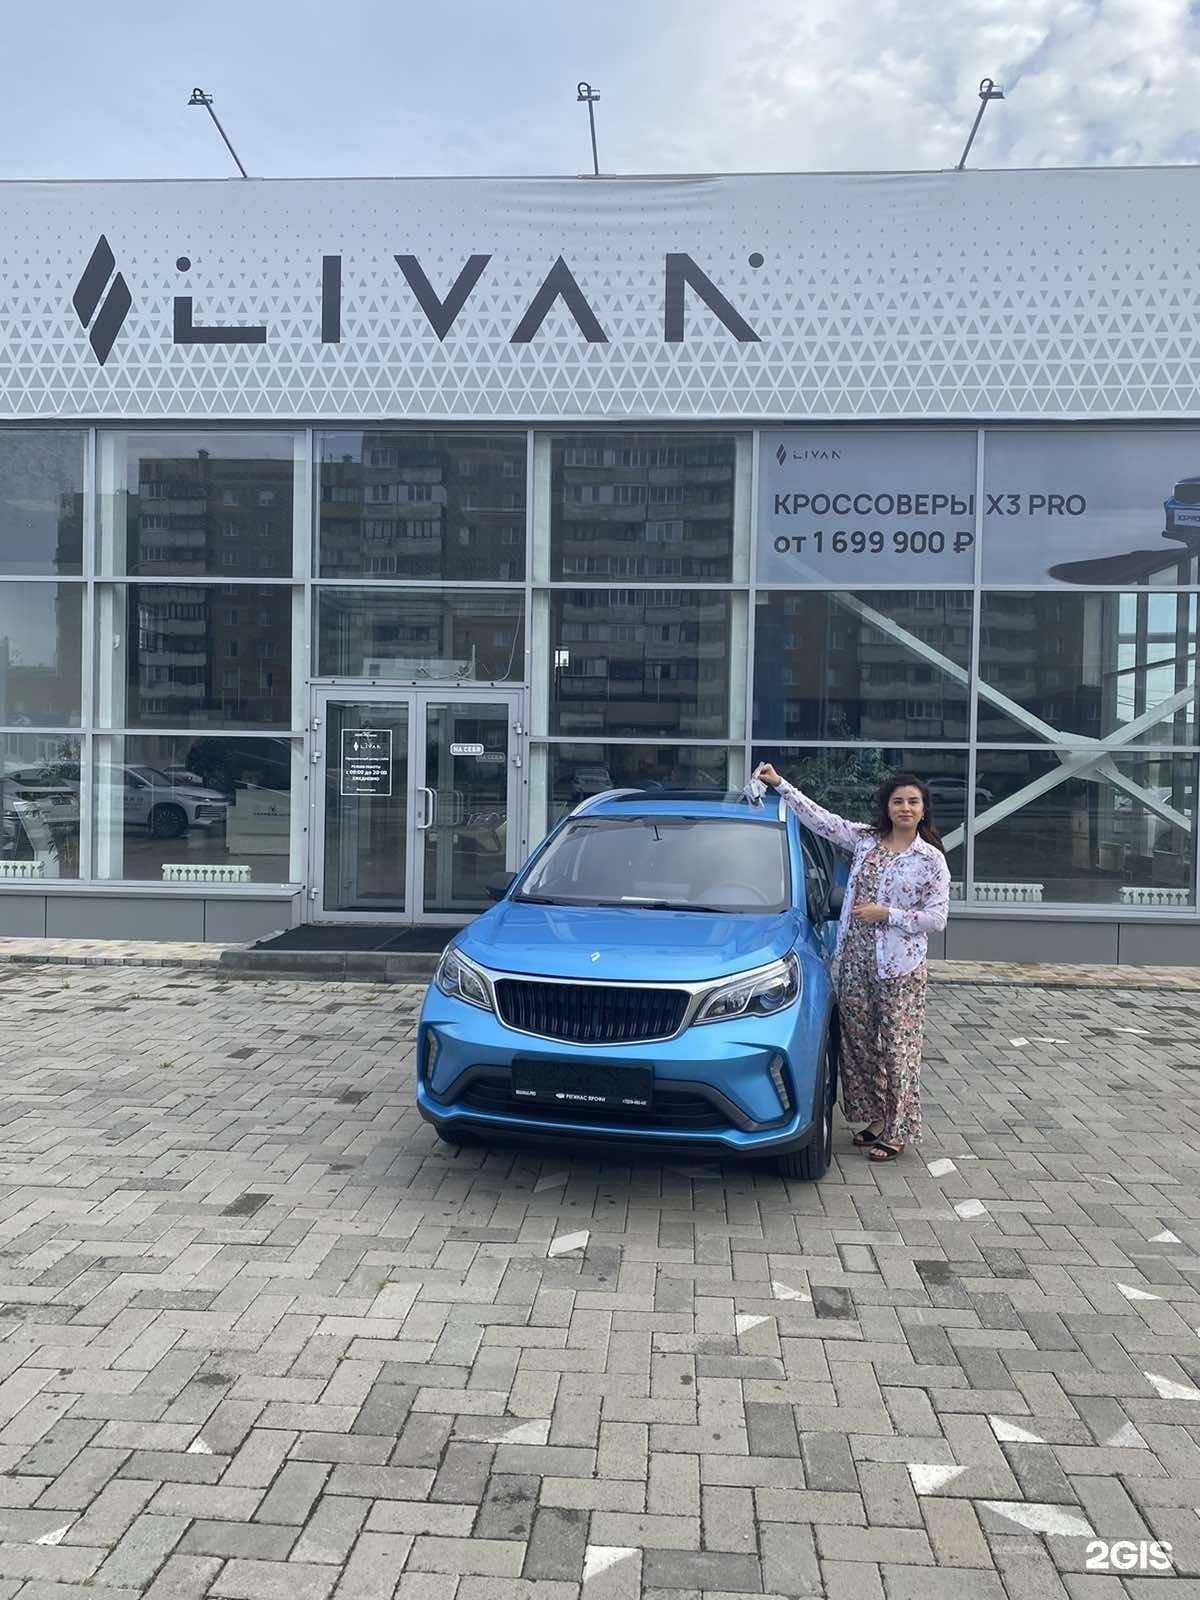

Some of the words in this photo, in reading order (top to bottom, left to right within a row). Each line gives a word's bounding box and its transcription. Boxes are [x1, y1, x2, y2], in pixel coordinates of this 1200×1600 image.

[173, 252, 765, 344] LIVAN
[792, 450, 841, 460] LIVAN
[774, 493, 975, 516] КРОССОВЕРЫ
[986, 493, 1021, 516] X3
[1029, 493, 1087, 516] PRO
[773, 535, 807, 554] от
[813, 531, 823, 553] 1
[832, 531, 885, 554] 699
[893, 531, 946, 554] 900
